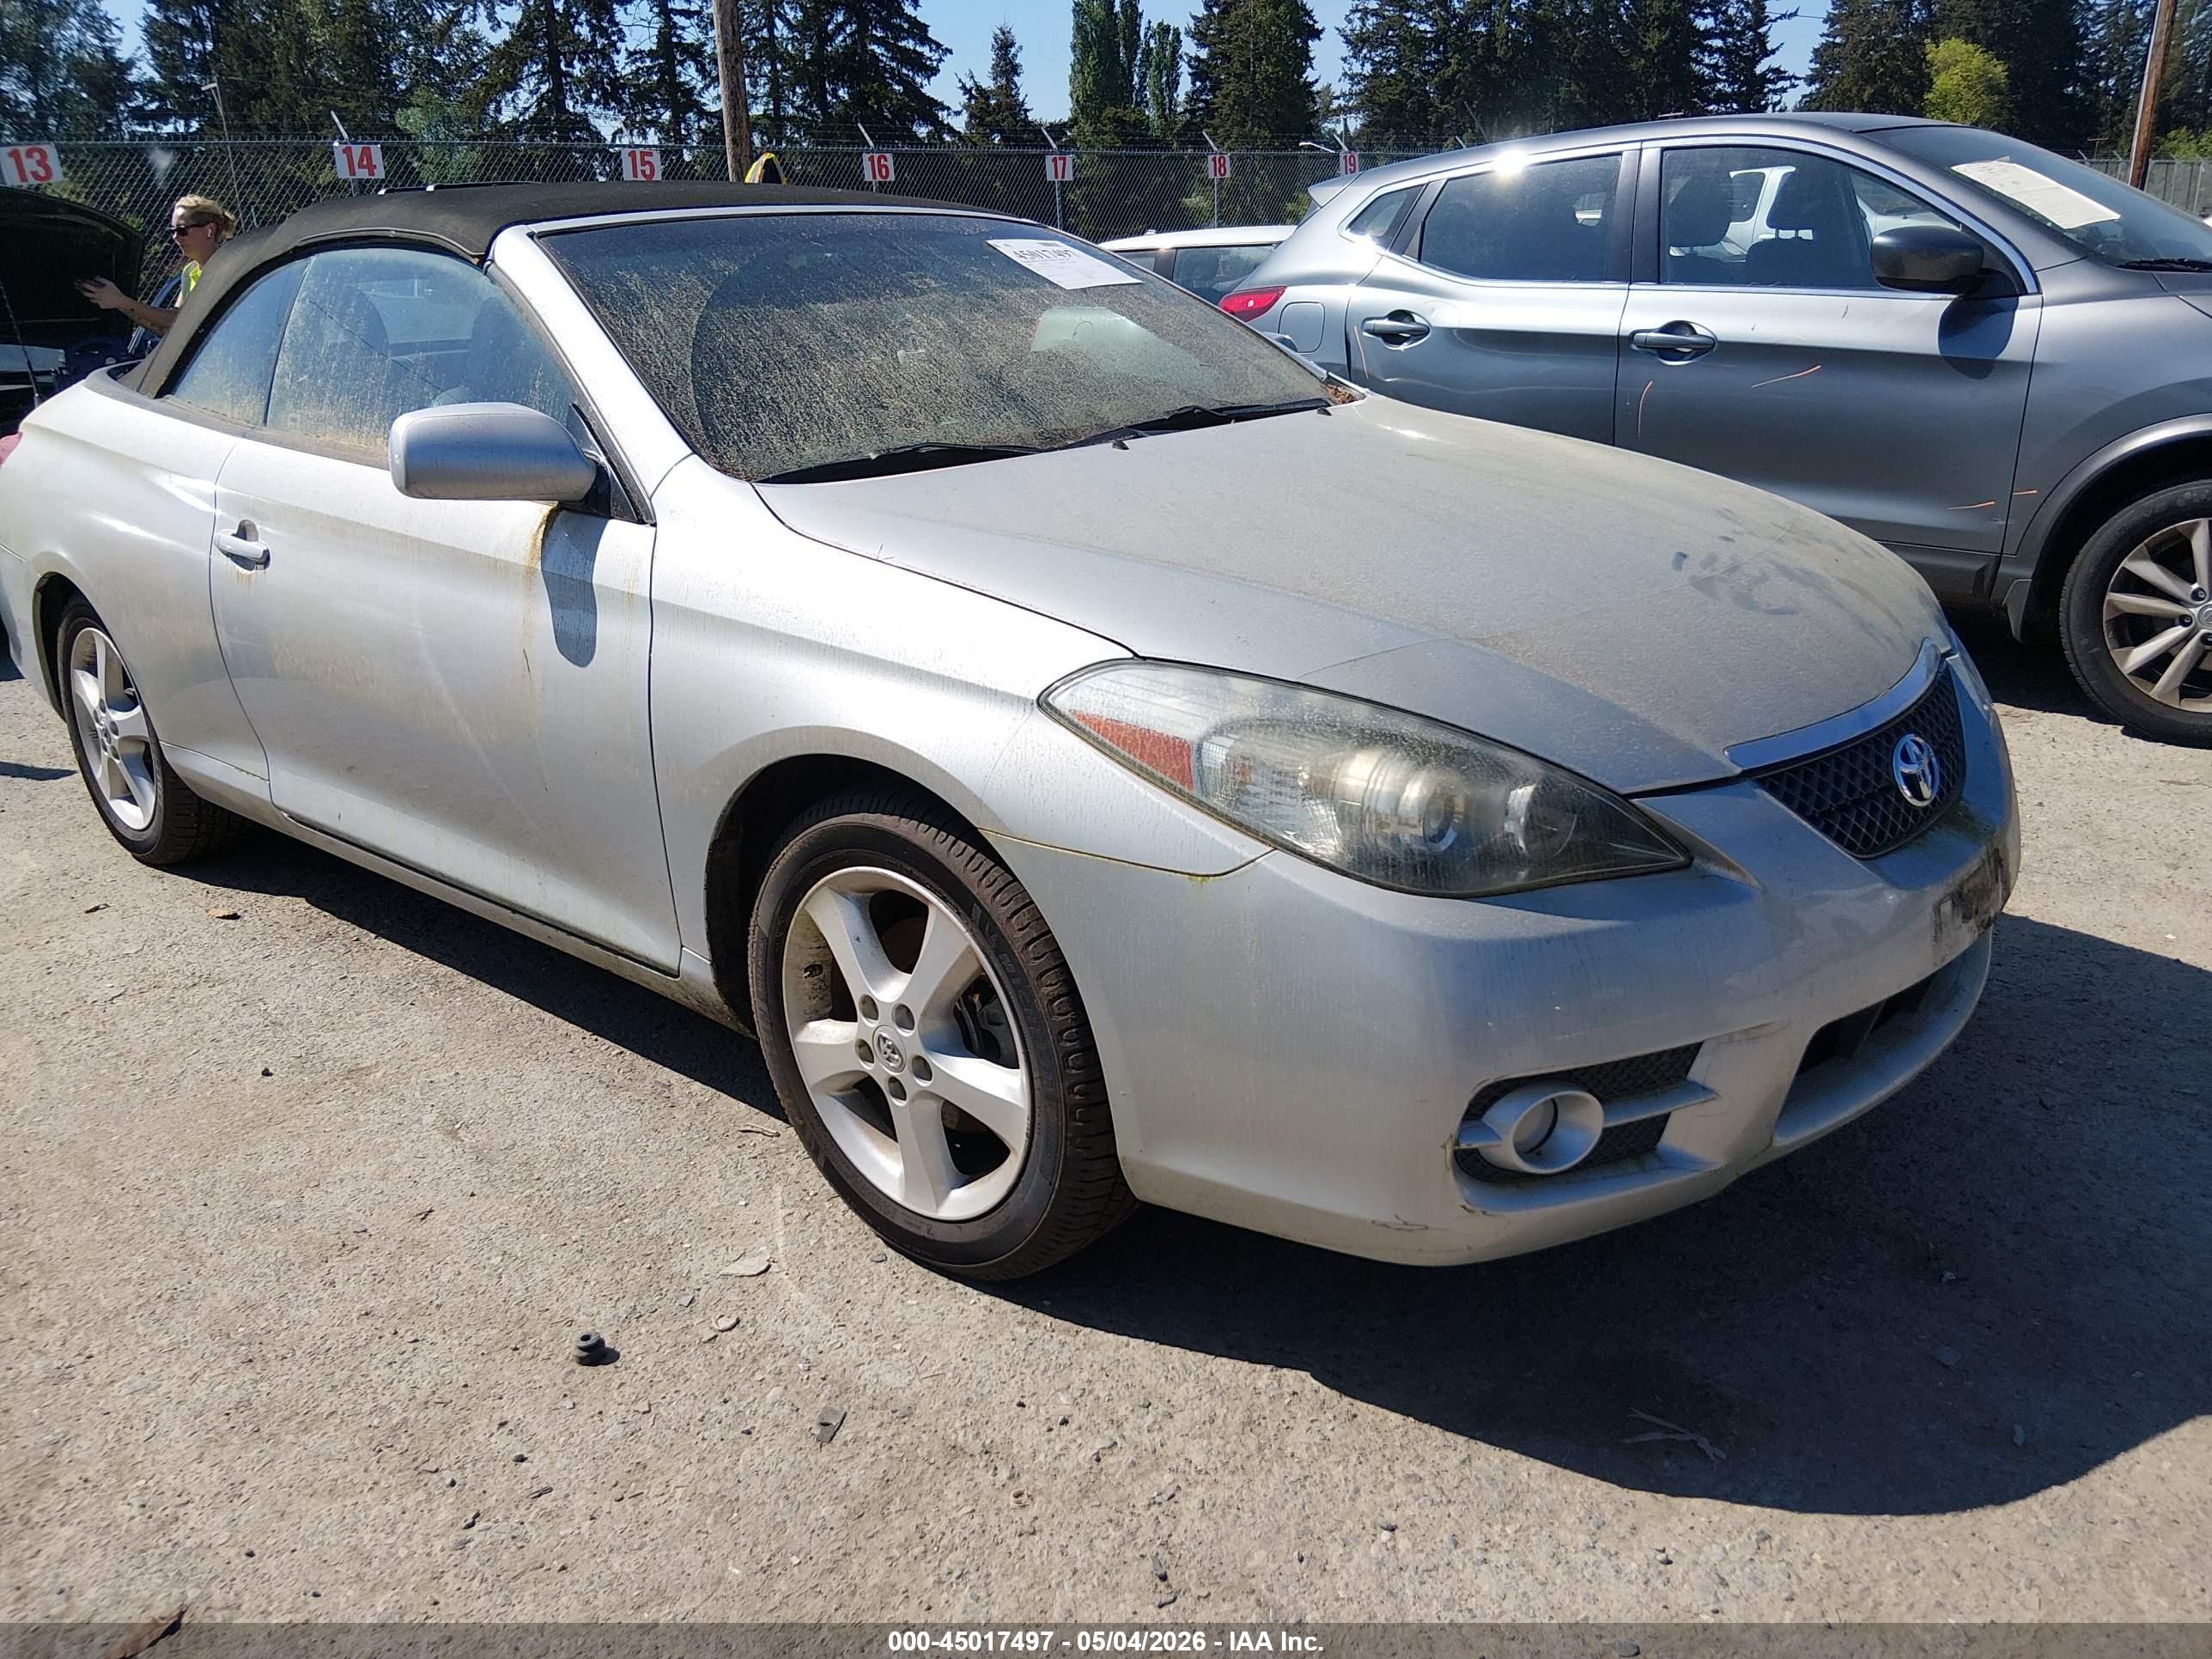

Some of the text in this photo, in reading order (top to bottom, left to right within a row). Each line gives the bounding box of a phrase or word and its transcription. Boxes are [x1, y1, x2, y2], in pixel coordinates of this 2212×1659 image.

[8, 146, 53, 183] 13
[343, 146, 377, 177] 14
[628, 149, 655, 180] 15
[867, 154, 890, 180] 16
[1051, 156, 1066, 179] 17
[1211, 155, 1227, 177] 18
[1342, 154, 1357, 175] 19
